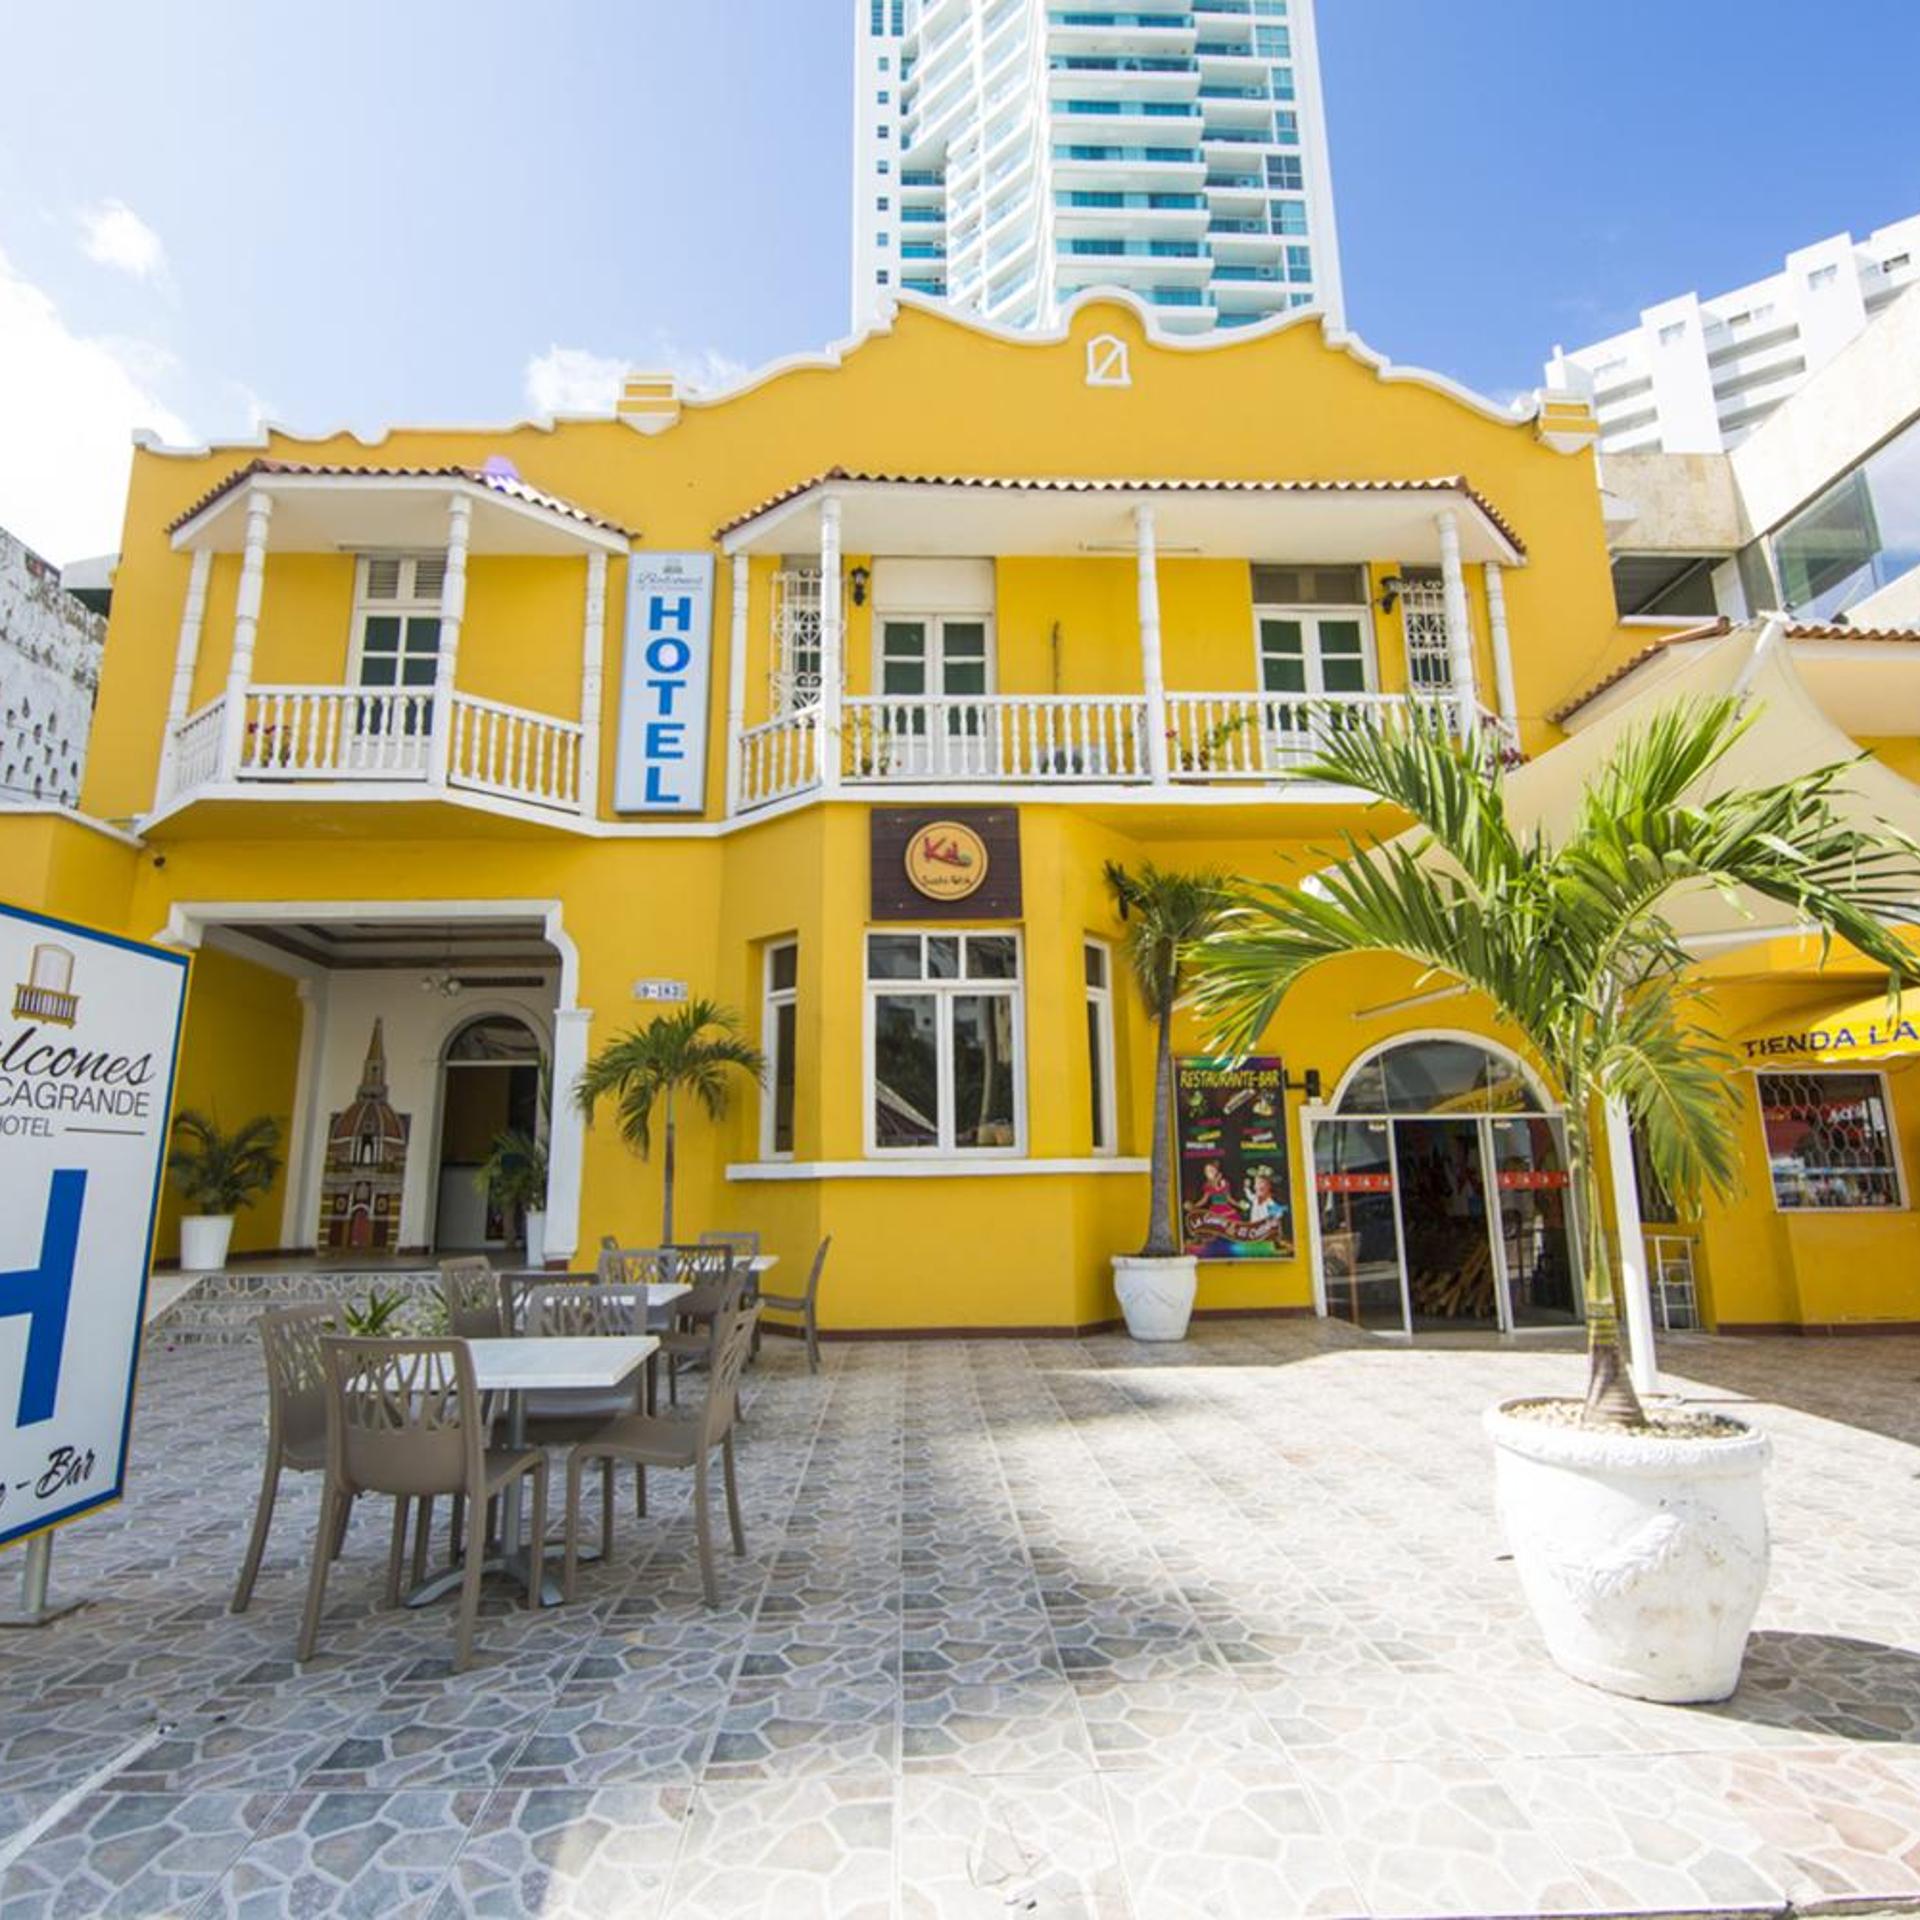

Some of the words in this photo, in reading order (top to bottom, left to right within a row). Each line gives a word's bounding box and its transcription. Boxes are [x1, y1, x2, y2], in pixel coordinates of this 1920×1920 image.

[644, 596, 691, 803] HOTEL
[0, 1026, 154, 1085] lcones
[1743, 1028, 1857, 1058] TIENDA
[1869, 1021, 1918, 1045] LA
[0, 1115, 54, 1137] OTEL
[35, 1446, 95, 1499] Bar
